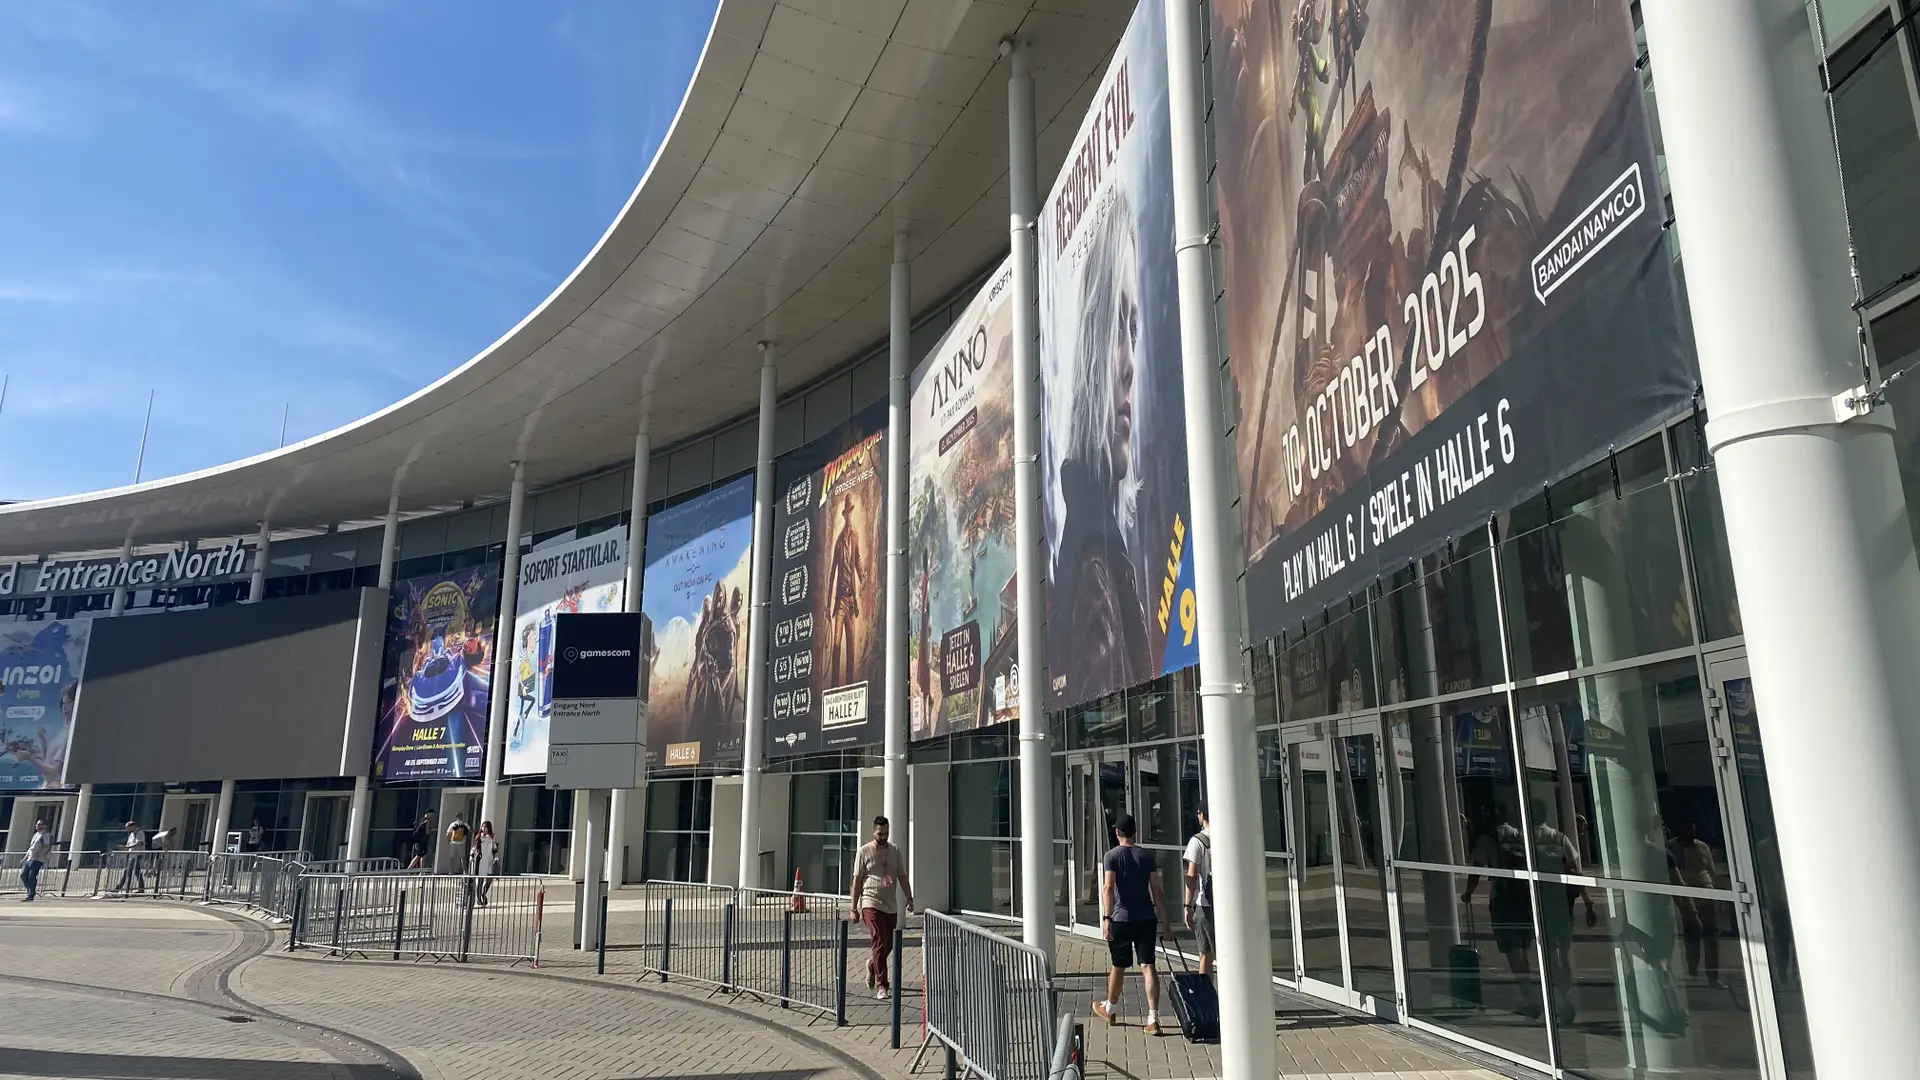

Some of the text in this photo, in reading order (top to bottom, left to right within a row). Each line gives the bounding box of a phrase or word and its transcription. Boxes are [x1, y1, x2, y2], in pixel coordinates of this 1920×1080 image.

[1056, 56, 1134, 261] RESIDENT EVIL
[1538, 183, 1636, 287] BANDAI NAMCO
[930, 324, 988, 418] ANNO
[1282, 224, 1486, 502] 10 OCTOBER 2025
[1282, 549, 1304, 603] PLAY
[1305, 541, 1317, 588] IN
[1317, 523, 1346, 580] HALL
[1346, 513, 1356, 562] 6
[1360, 504, 1365, 554] /
[1369, 471, 1414, 547] SPIELE
[1414, 456, 1434, 519] IN
[1435, 412, 1495, 505] HALLE
[1497, 397, 1515, 465] 6
[34, 557, 158, 592] Entrance
[160, 540, 246, 581] North
[523, 539, 620, 586] SOFORT STARTKLAR.
[665, 537, 726, 569] AWAKENING
[673, 583, 683, 592] OUT
[684, 579, 695, 588] NOW
[703, 572, 712, 582] PC
[1157, 512, 1186, 635] HALLE
[428, 591, 459, 608] SONIC
[1179, 588, 1196, 647] 9
[580, 648, 631, 659] gamescom
[949, 628, 970, 653] JETZT IN
[946, 644, 975, 675] HALLE 6
[949, 670, 970, 691] SPIELEN
[553, 702, 578, 710] Eingang
[828, 701, 859, 721] HALLE 7
[412, 727, 446, 741] HALLE 7
[670, 748, 690, 760] HALLE
[690, 747, 696, 759] 6
